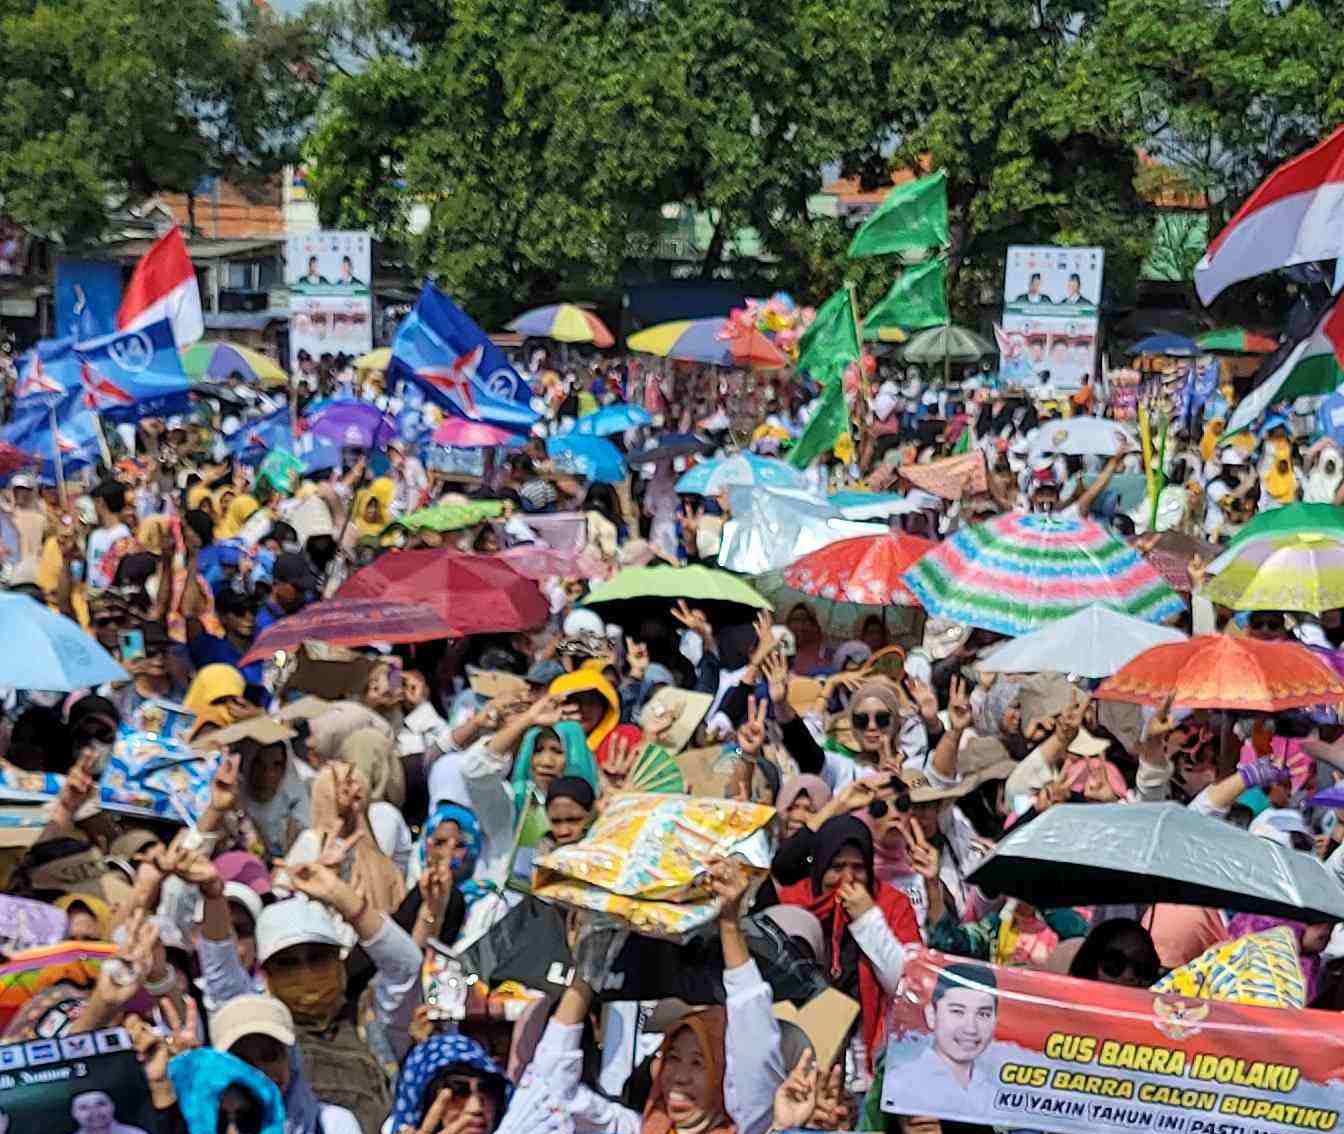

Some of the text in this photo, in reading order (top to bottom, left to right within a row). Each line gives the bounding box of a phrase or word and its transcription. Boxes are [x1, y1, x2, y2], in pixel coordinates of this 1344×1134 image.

[1045, 1031, 1301, 1094] GUS BARRA IDOLAKU
[999, 1062, 1339, 1131] GUS BARRA CALON BUPATIKU
[999, 1092, 1023, 1108] KU
[1029, 1095, 1085, 1117] YAKIN
[1091, 1105, 1154, 1126] TAHUN
[1157, 1114, 1186, 1132] INI
